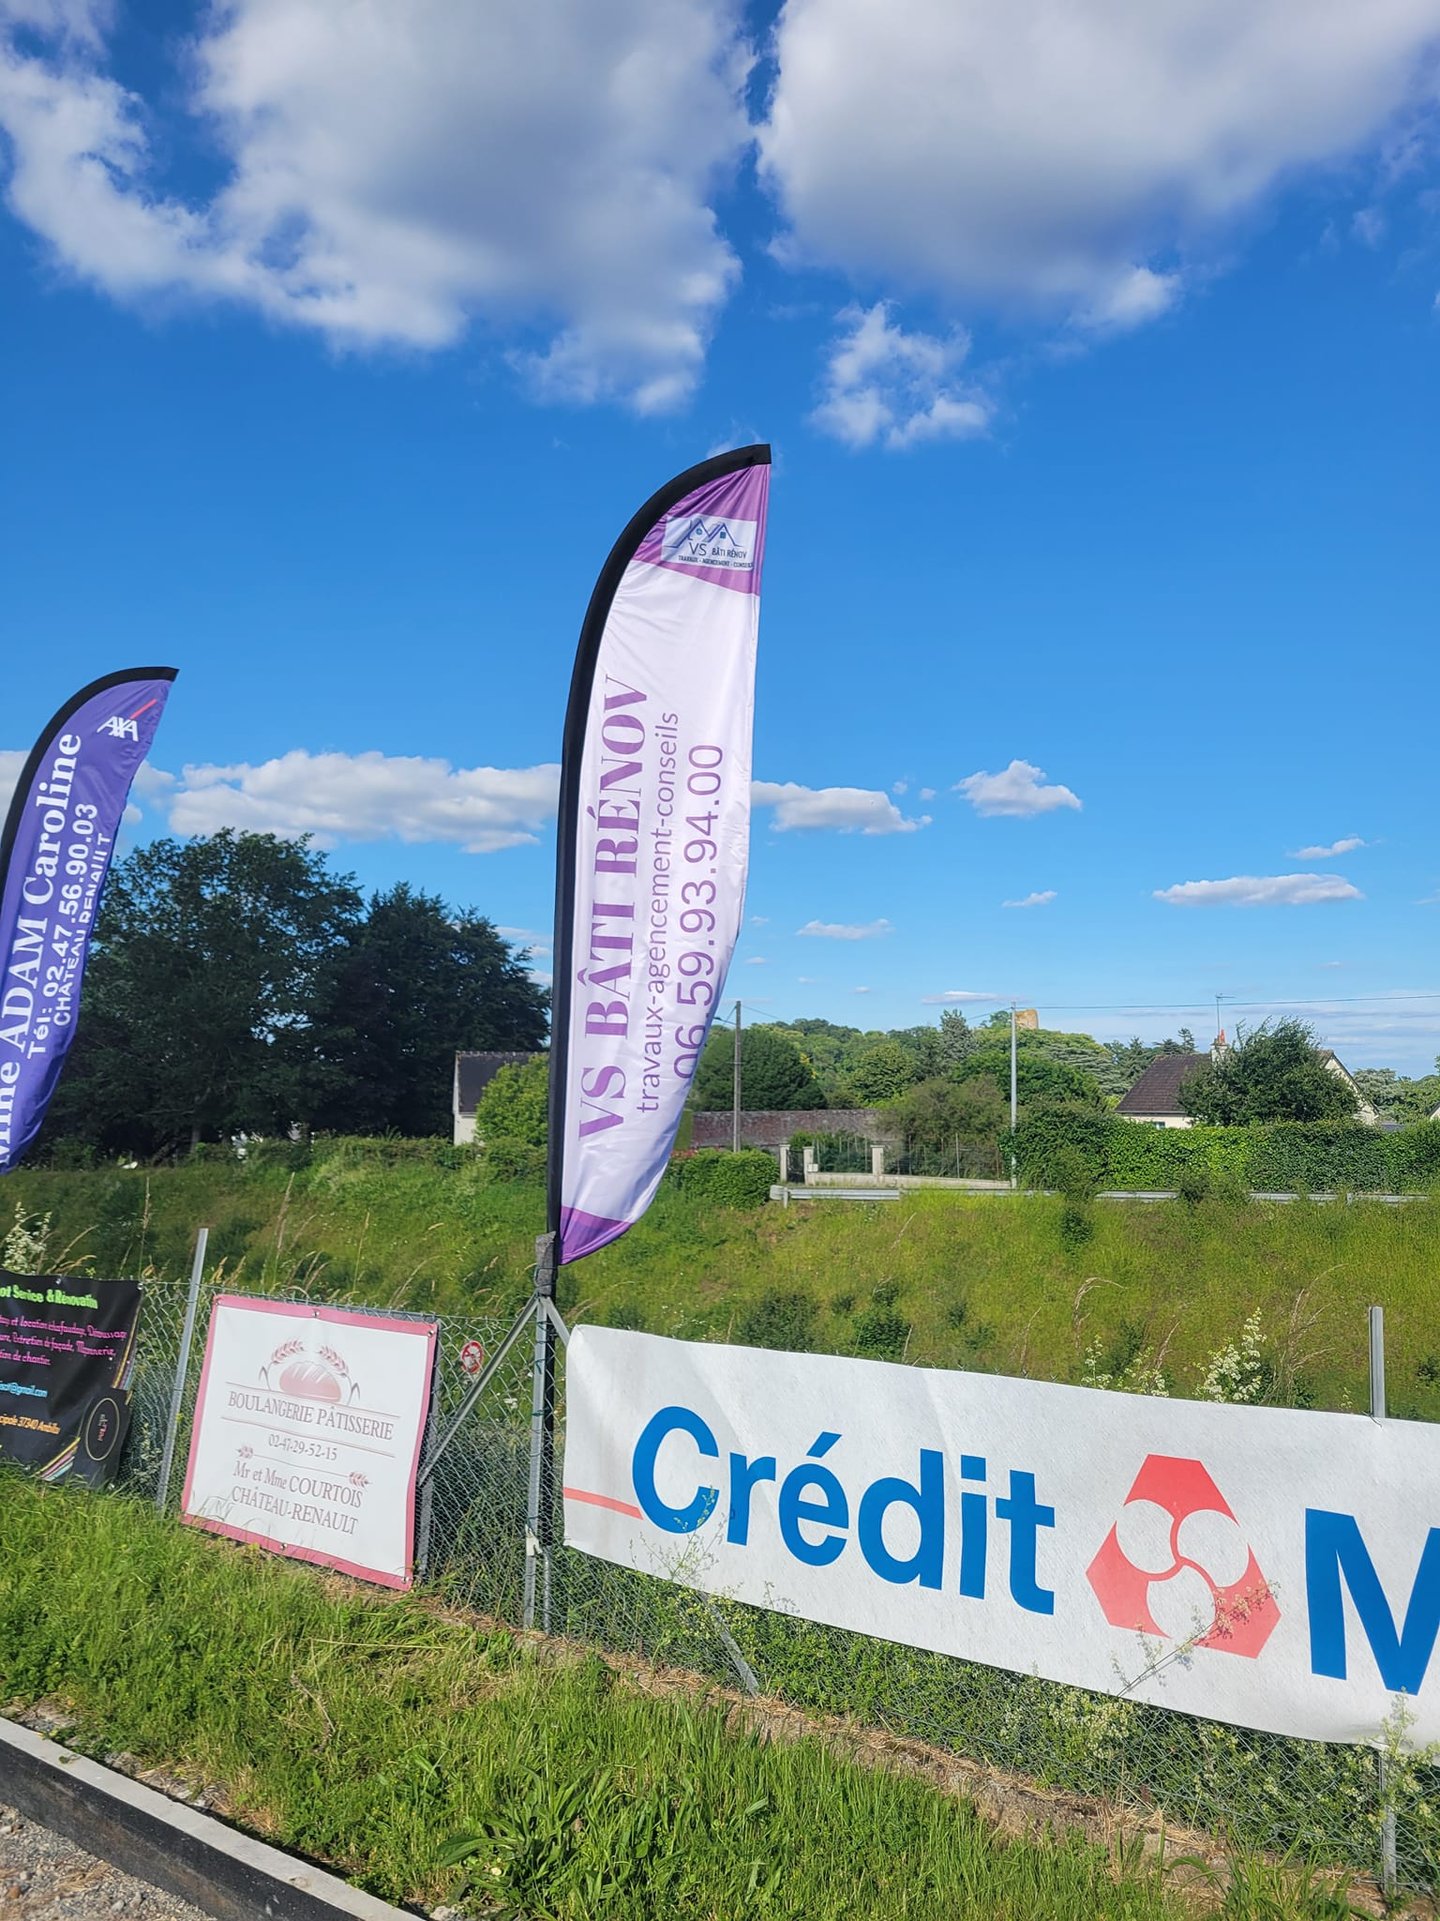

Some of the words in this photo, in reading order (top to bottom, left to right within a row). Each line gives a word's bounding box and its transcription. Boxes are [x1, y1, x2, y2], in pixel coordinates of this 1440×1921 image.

[689, 542, 707, 556] VS
[97, 715, 139, 742] AXA
[587, 674, 647, 878] RÉNOV
[23, 734, 81, 905] Caroline
[577, 901, 635, 1039] BÂTI
[637, 712, 679, 1113] travaux-agencement-conseils
[673, 745, 723, 1079] 06.59.93.94.00
[0, 915, 48, 1053] ADAM
[578, 1065, 626, 1141] VS
[228, 1390, 314, 1423] BOULANGERIE
[316, 1405, 394, 1440] PÂTISSERIE
[233, 1460, 251, 1479] Mr
[252, 1469, 263, 1482] et
[264, 1467, 287, 1490] Mme
[289, 1475, 363, 1508] COURTOIS
[232, 1485, 358, 1535] CHÂTEAU-RENAULT
[632, 1405, 1055, 1615] Crédit
[1305, 1507, 1440, 1695] M
